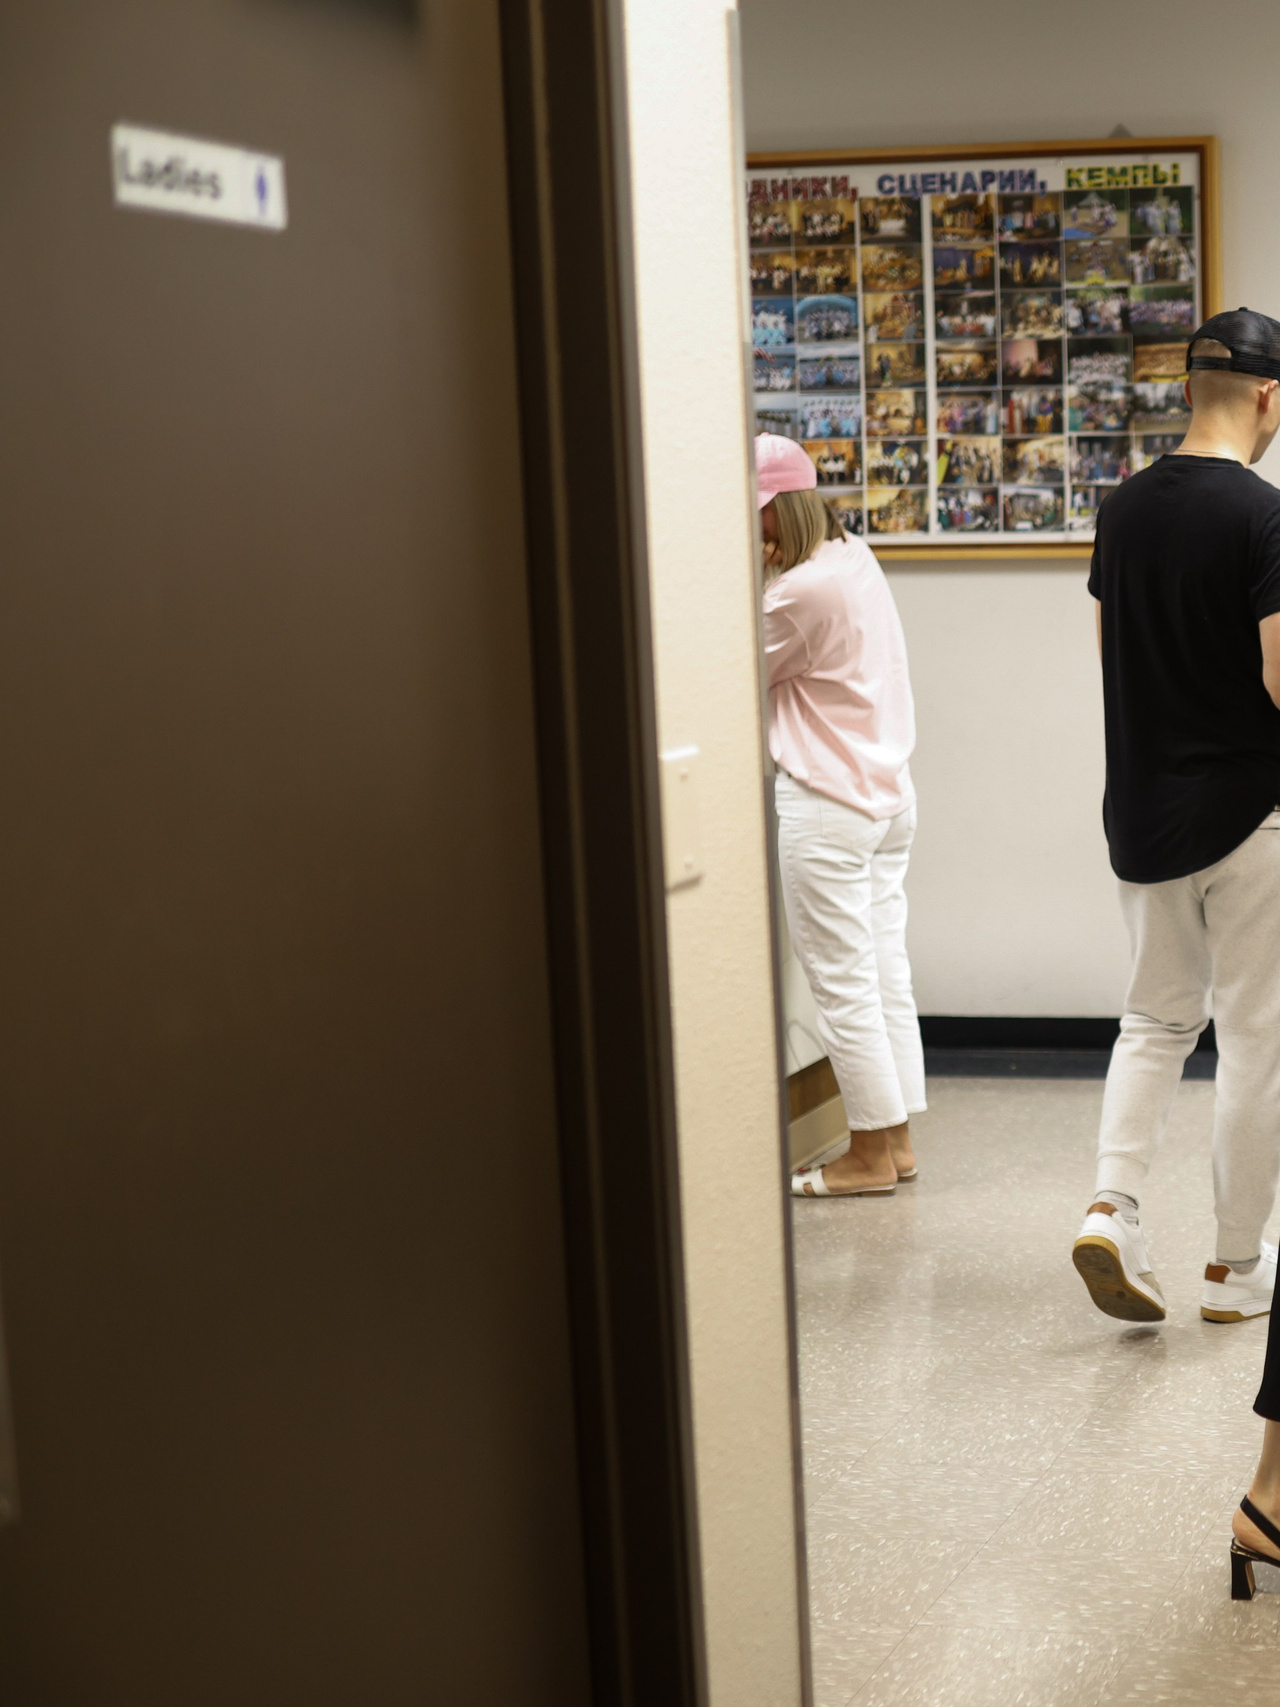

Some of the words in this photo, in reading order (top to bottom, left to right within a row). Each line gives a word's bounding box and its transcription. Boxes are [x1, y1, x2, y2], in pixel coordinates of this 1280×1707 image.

[746, 175, 858, 203] ДНИКИ,
[876, 169, 1047, 198] СЦЕНАРИИ,
[1065, 162, 1180, 187] КЕМПЫ
